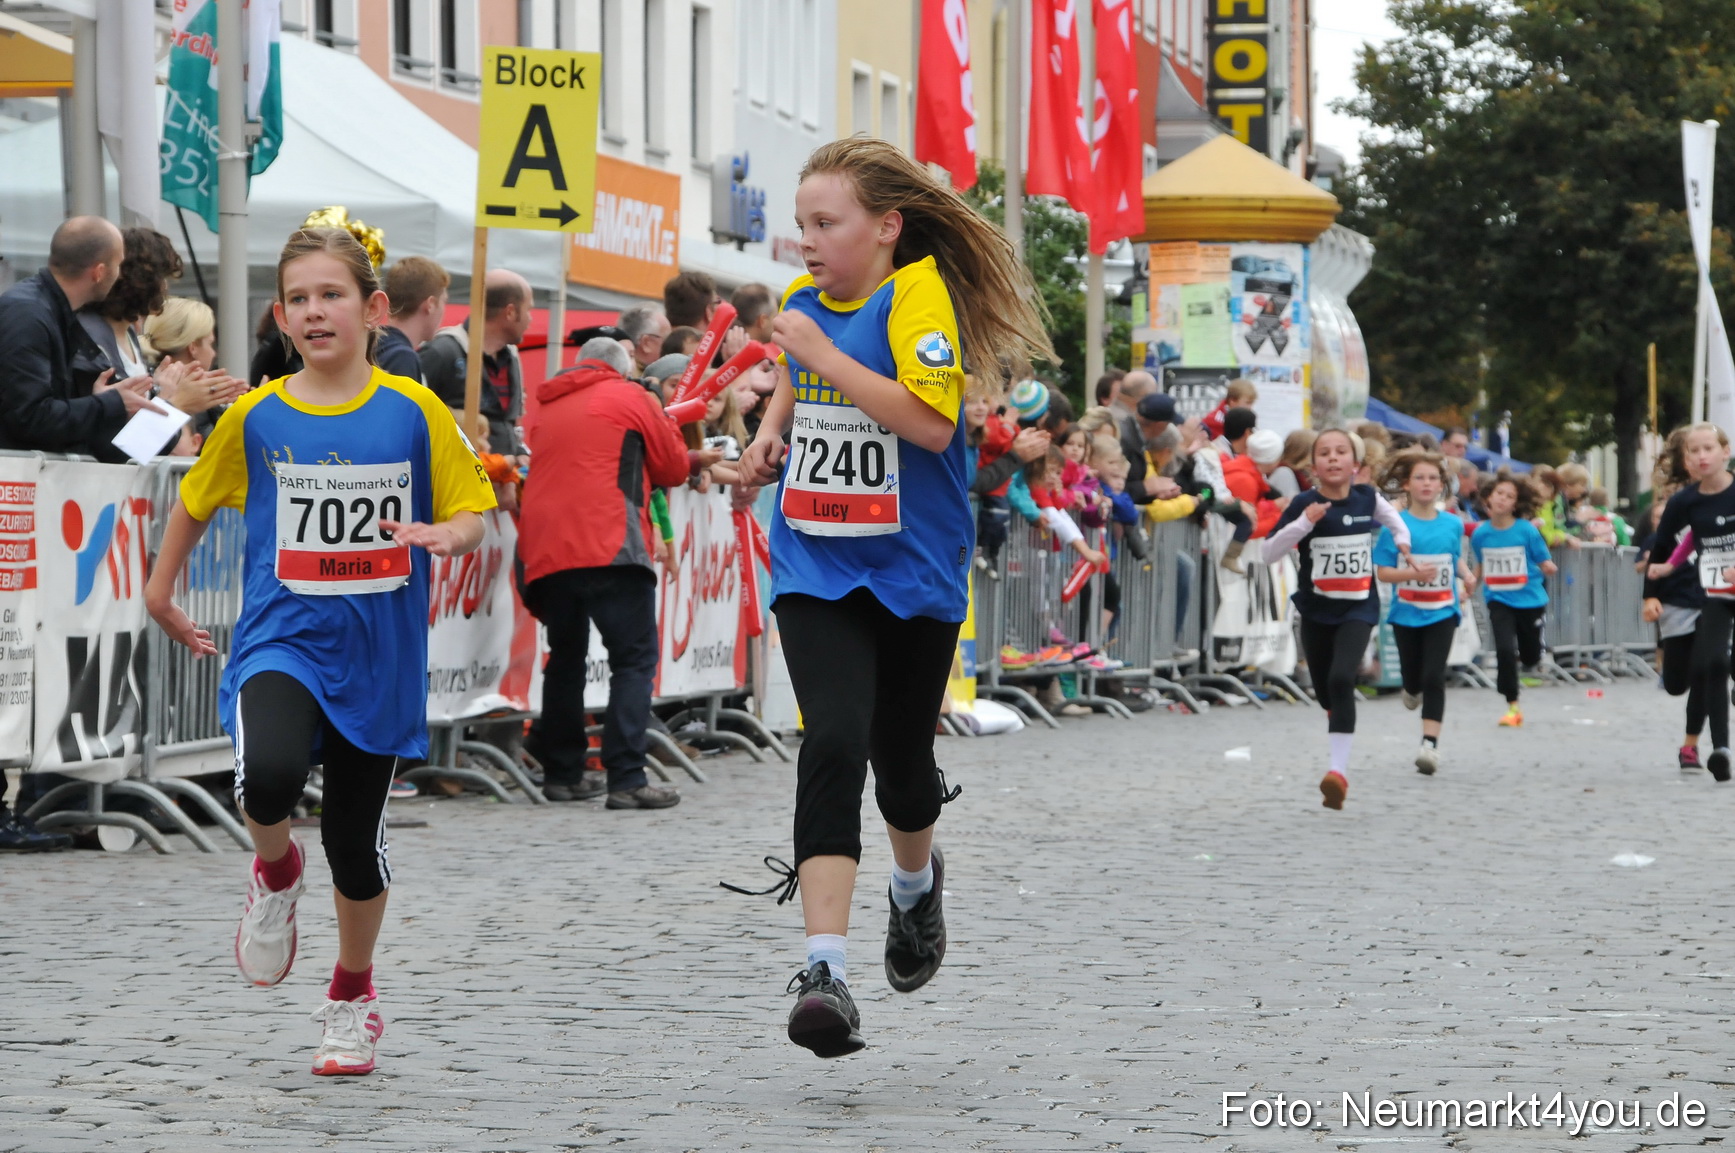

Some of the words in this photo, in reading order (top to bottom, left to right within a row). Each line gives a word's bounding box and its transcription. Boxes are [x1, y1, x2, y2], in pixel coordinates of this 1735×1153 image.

[495, 54, 586, 89] Block
[501, 104, 568, 191] A
[795, 415, 814, 430] PARTL
[816, 418, 872, 433] Neumarkt
[795, 436, 886, 487] 7240
[279, 476, 323, 490] PARTL
[327, 477, 393, 491] Neumarkt
[886, 473, 895, 483] M
[290, 495, 402, 545] 7020
[813, 498, 849, 522] Lucy
[319, 558, 372, 576] Maria
[1320, 550, 1368, 575] 7552
